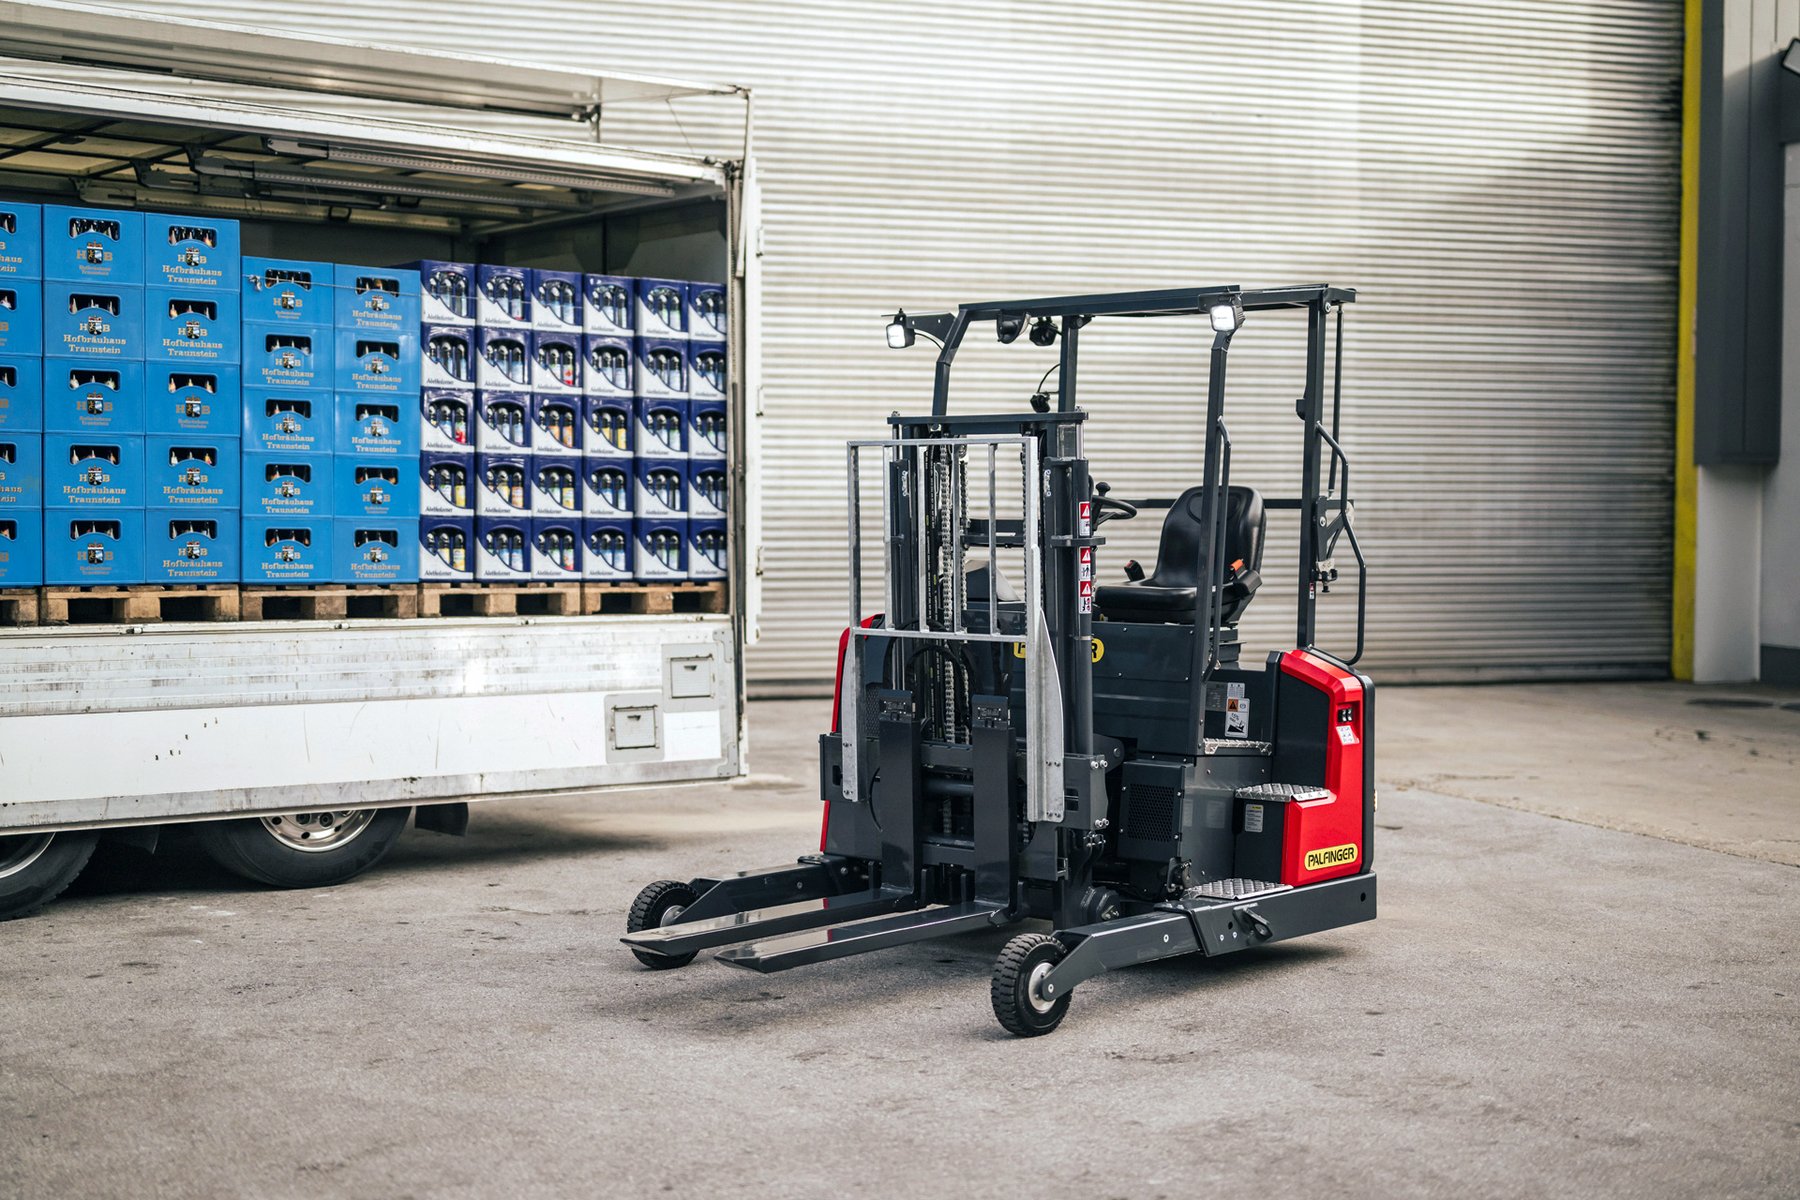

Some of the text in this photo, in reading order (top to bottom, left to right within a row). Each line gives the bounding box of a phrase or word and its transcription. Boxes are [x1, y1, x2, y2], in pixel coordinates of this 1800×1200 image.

[163, 265, 222, 276] Hofbräuhaus
[167, 275, 218, 285] Traunstein
[64, 335, 126, 345] Hofbräuhaus
[163, 339, 222, 349] Hofbräuhaus
[69, 344, 120, 354] Traunstein
[168, 348, 217, 357] Traunstein
[64, 486, 126, 494] Hofbräuhaus
[163, 486, 223, 494] Hofbräuhaus
[168, 496, 218, 504] Traunstein
[1308, 847, 1354, 867] PALFINGER
